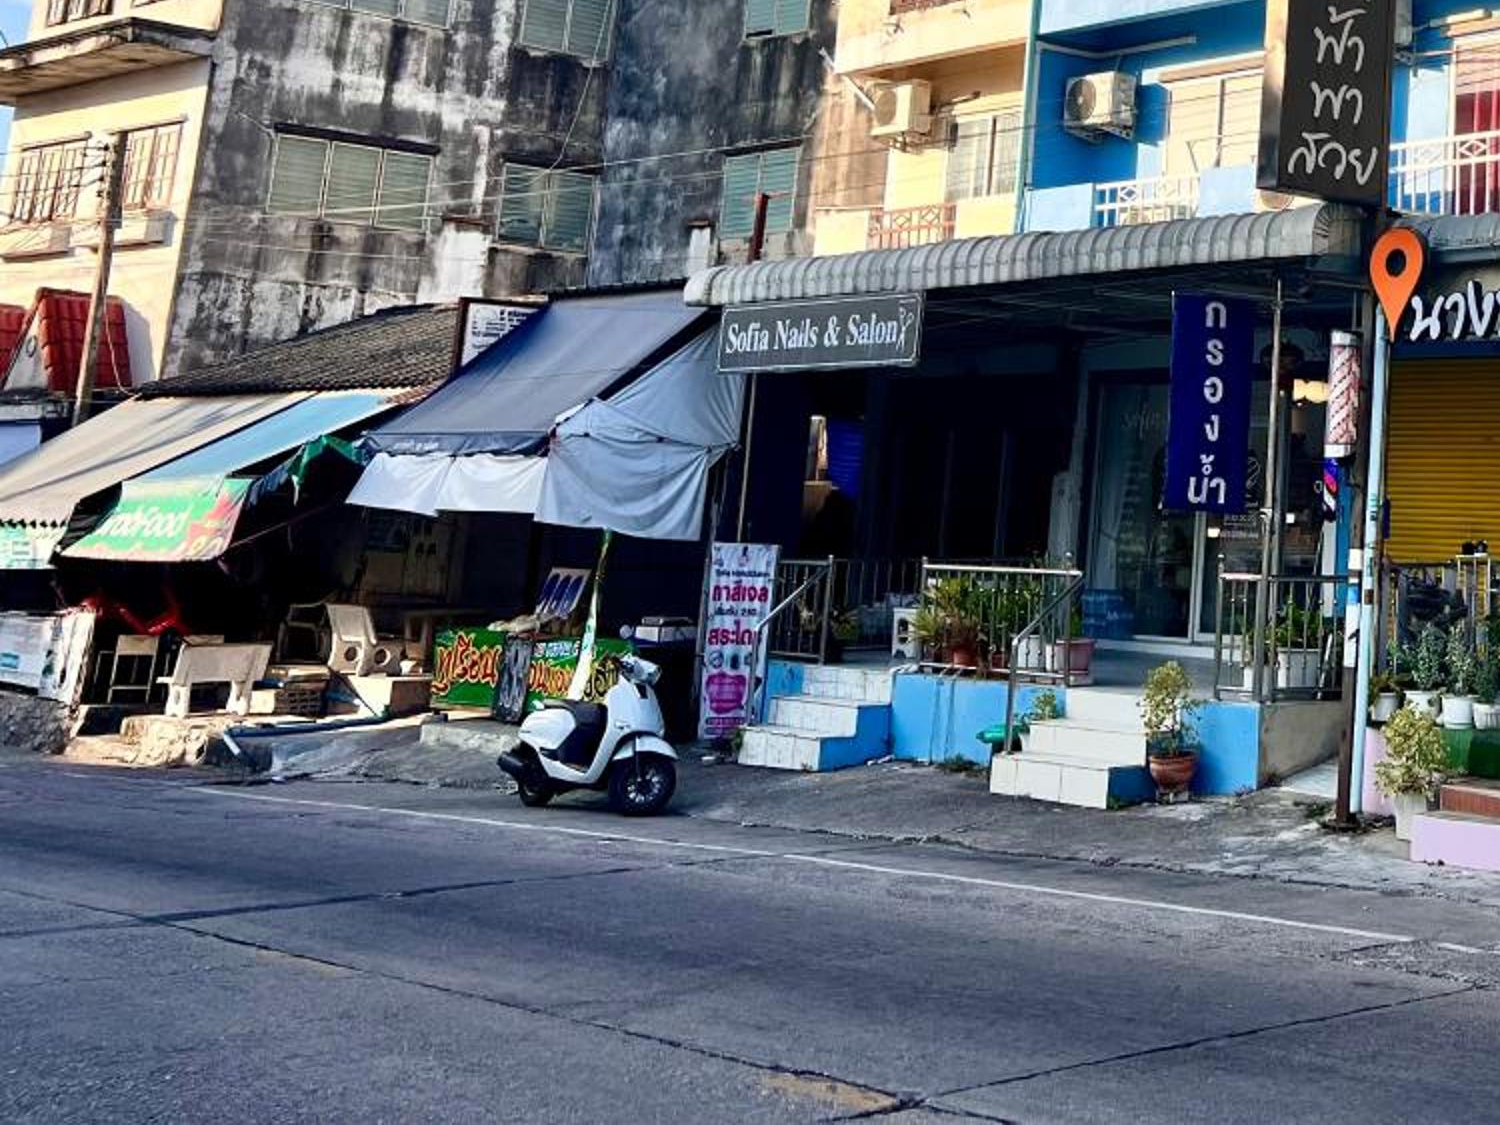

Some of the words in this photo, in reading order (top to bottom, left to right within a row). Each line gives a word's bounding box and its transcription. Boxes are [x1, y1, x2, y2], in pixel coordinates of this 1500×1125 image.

[1314, 6, 1367, 72] ฟ้า
[1311, 81, 1363, 124] พา
[1287, 132, 1378, 185] สวย
[725, 322, 769, 354] Sofia
[774, 318, 818, 350] Nails
[823, 315, 841, 347] &
[846, 312, 898, 346] Salon
[1187, 301, 1227, 504] กรองน้ำ
